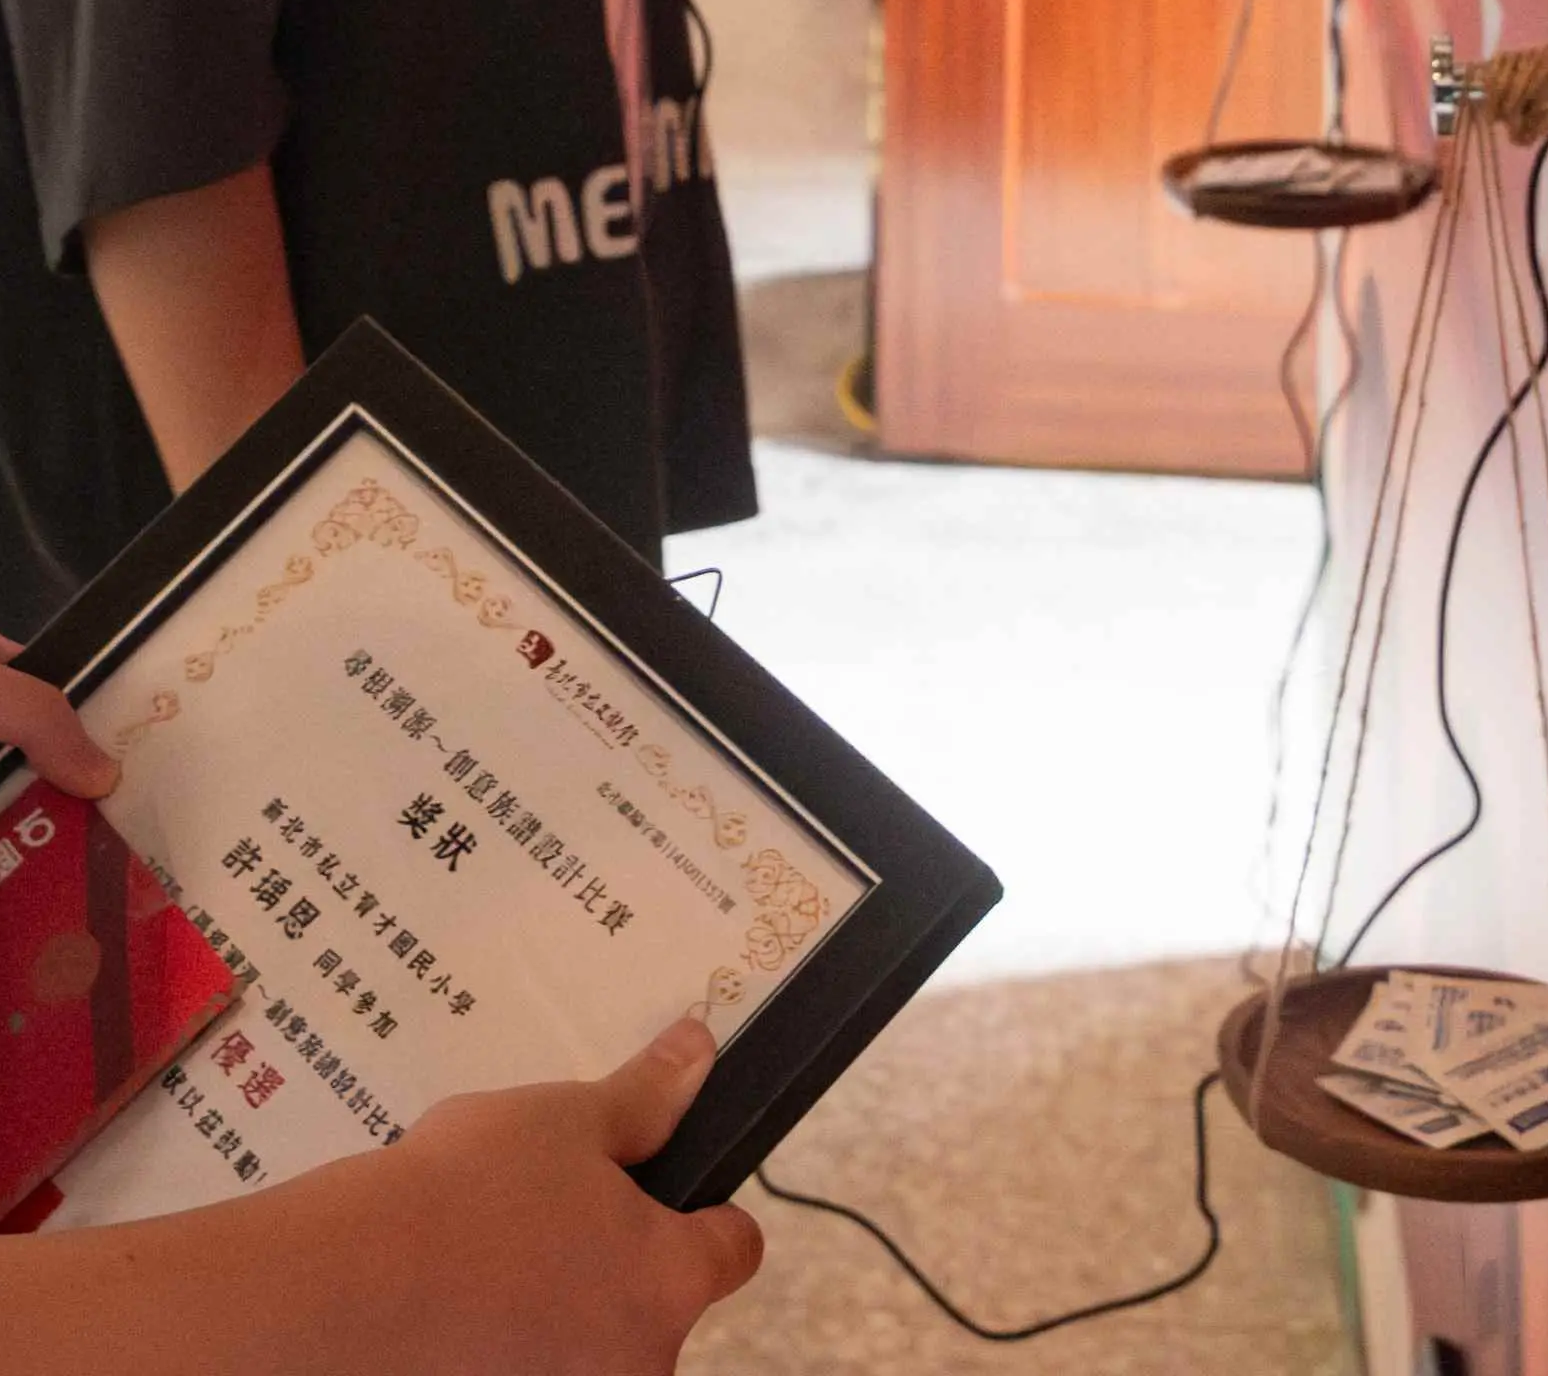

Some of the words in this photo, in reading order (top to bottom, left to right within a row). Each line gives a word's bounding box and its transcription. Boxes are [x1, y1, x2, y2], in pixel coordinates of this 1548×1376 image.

[396, 792, 477, 873] 獎狀
[261, 798, 476, 1016] 新北市私立育才國民小學
[312, 948, 398, 1039] 同學參加
[208, 1029, 286, 1109] 優選
